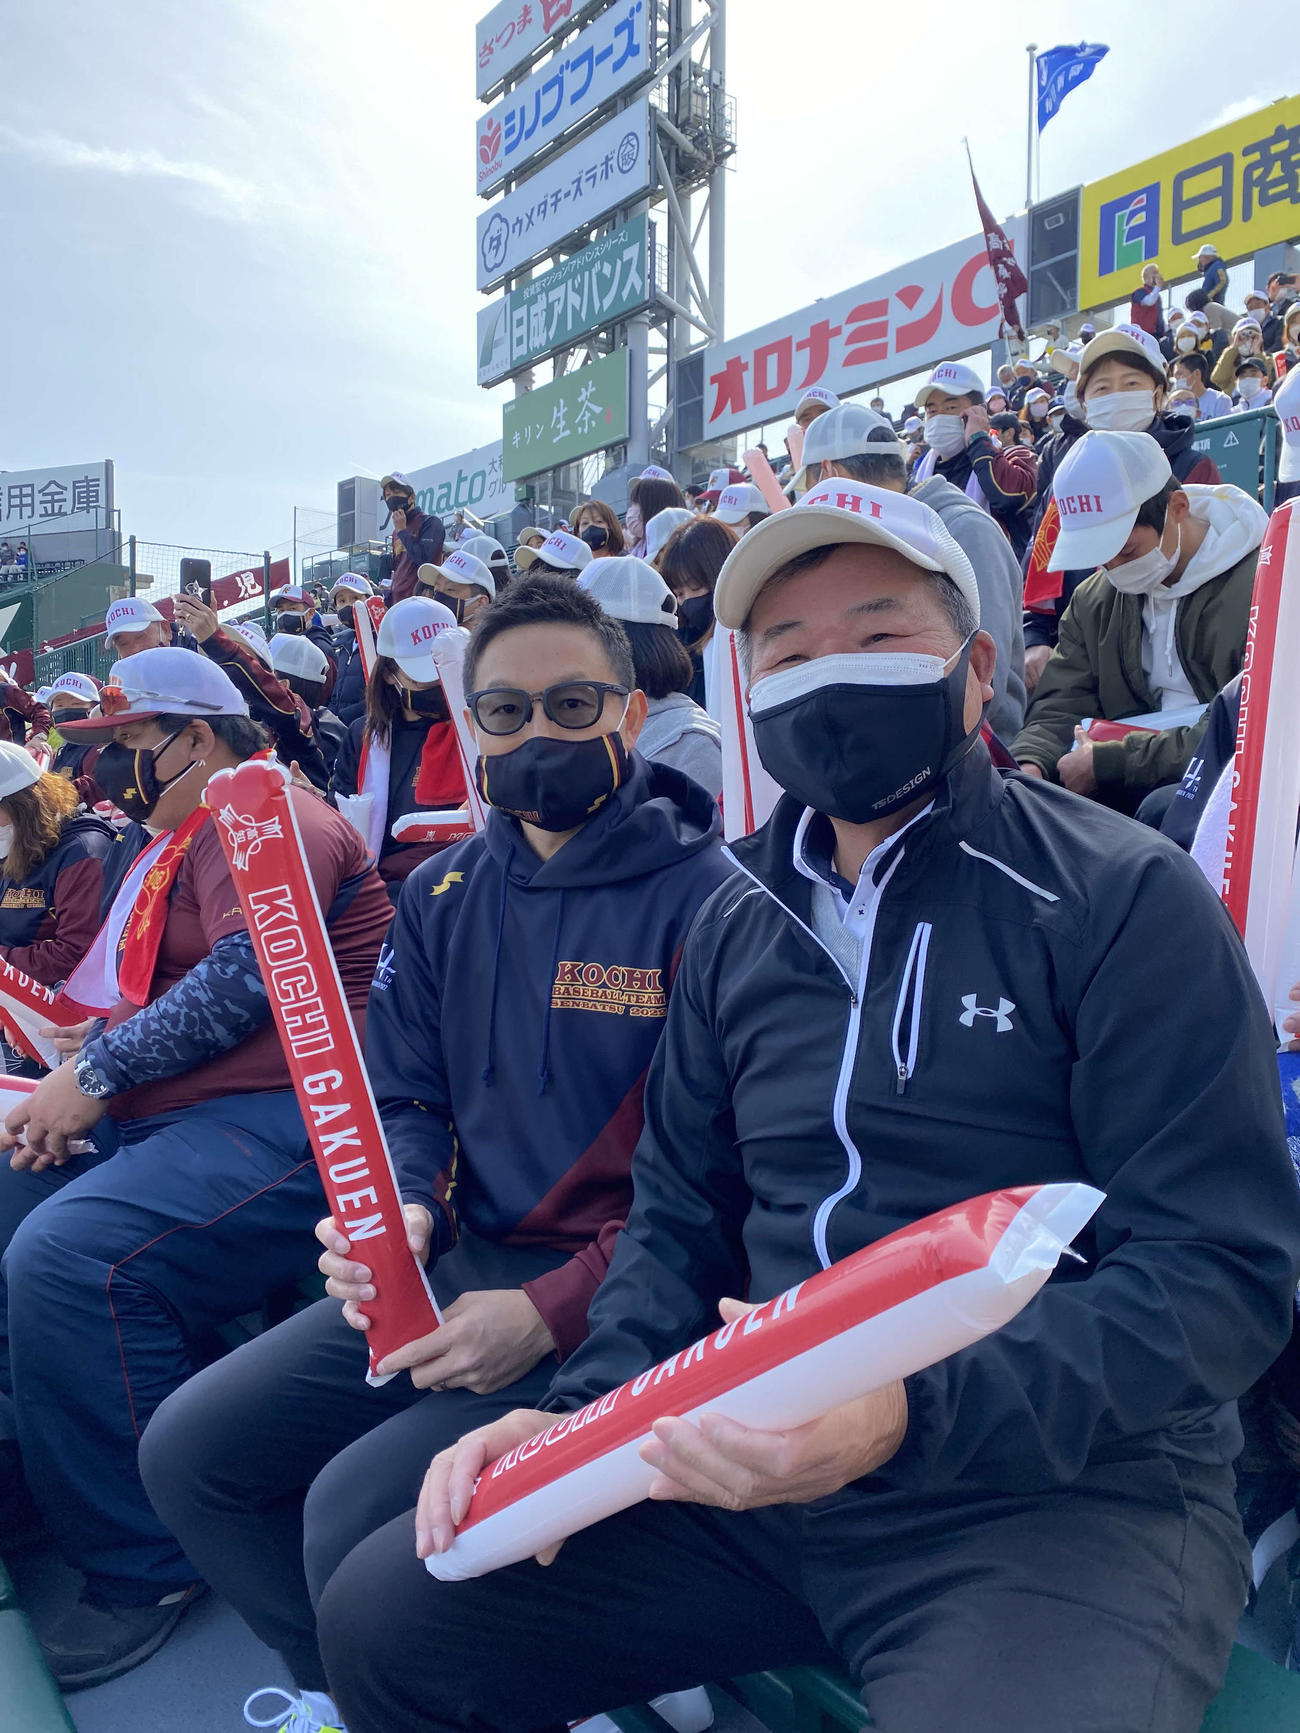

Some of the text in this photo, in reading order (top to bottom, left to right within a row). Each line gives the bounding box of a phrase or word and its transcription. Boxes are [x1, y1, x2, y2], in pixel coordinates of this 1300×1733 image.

[504, 1, 642, 156] シノブフーズ
[478, 160, 503, 183] Shinobu
[512, 150, 615, 237] ウメダチーズラボ
[1172, 123, 1300, 246] 日商
[709, 238, 1015, 424] オロナミンC
[511, 380, 604, 449] キリン 生茶
[0, 475, 100, 522] 用金庫
[415, 469, 487, 515] mato
[1057, 494, 1103, 516] OCHI
[552, 984, 666, 1006] BASEBALL TEAM
[555, 961, 664, 993] KOCHI
[550, 998, 667, 1017] SENBATSU 2022
[248, 884, 387, 1242] KOCHI GAKUEN
